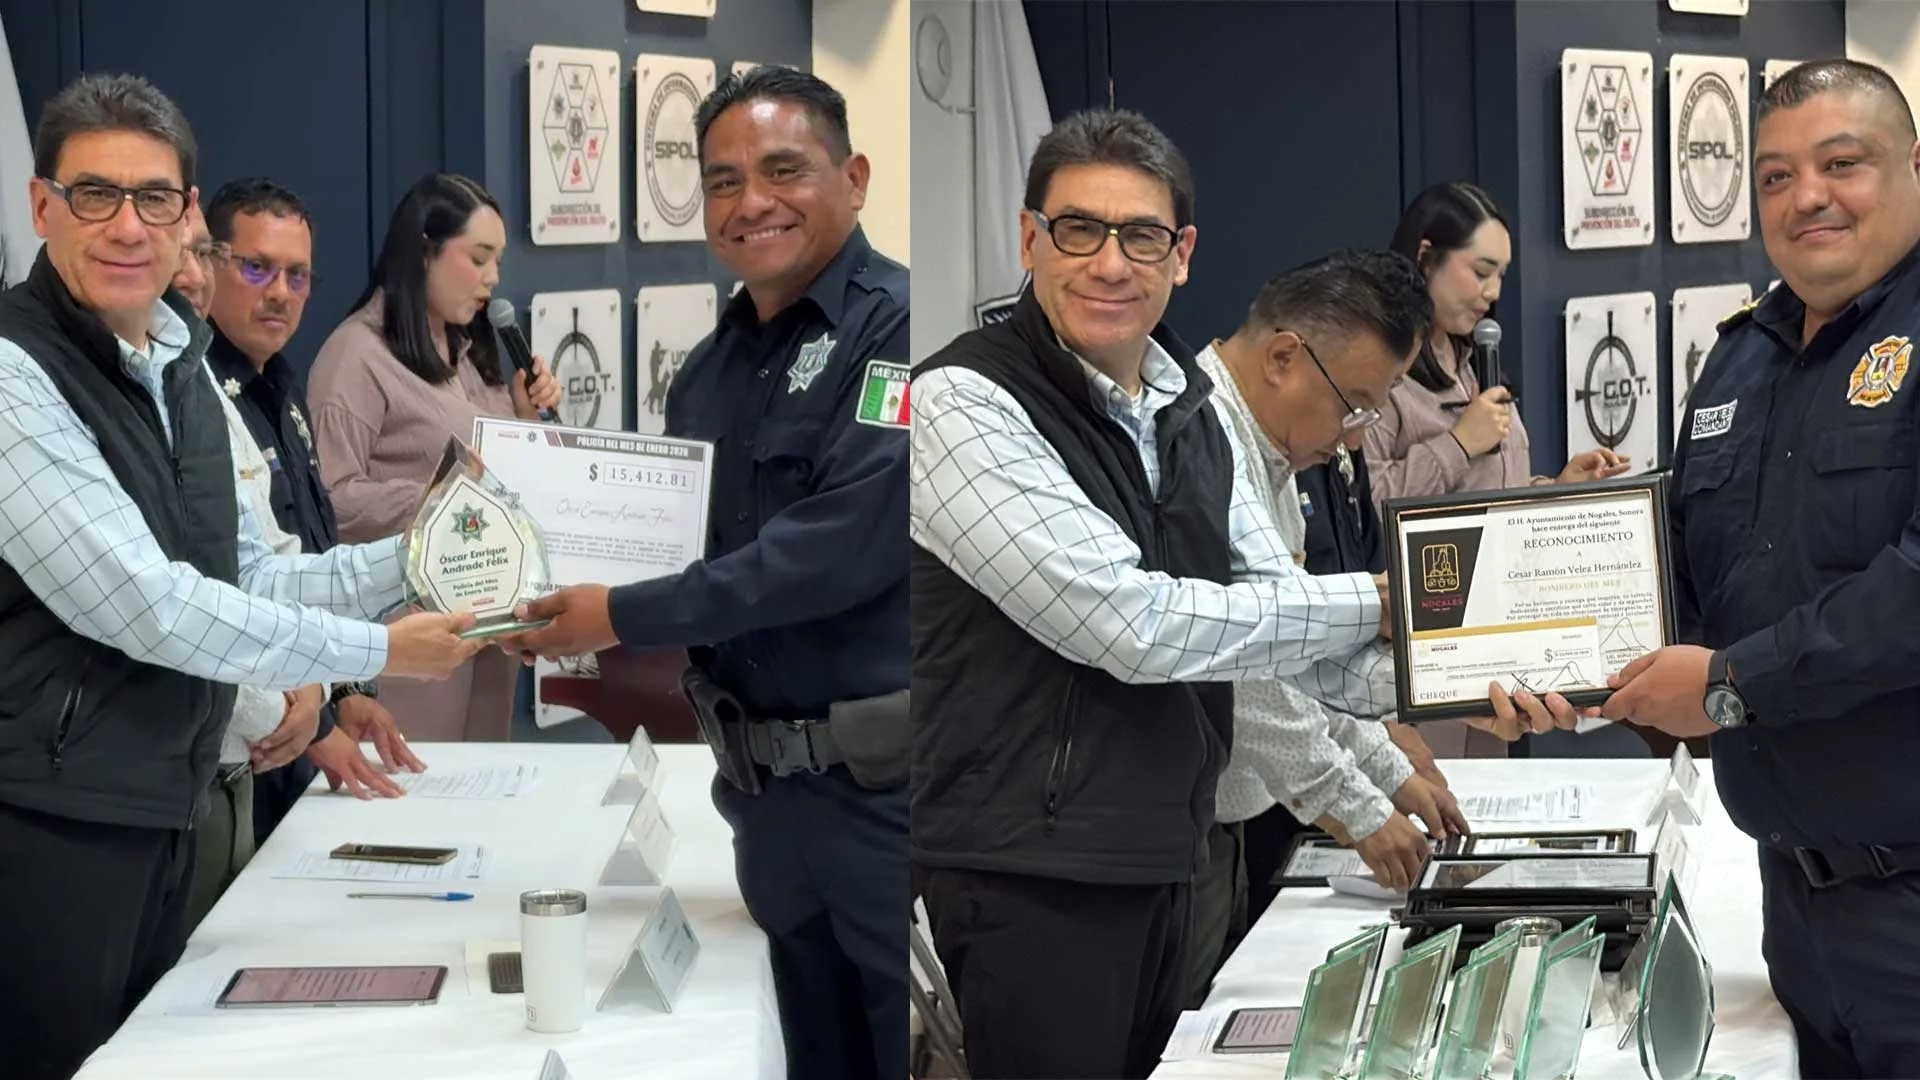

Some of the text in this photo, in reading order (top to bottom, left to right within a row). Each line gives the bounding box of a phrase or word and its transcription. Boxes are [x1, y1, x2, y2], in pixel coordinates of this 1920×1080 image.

[655, 141, 698, 159] SIPOL
[1689, 141, 1733, 159] SIPOL
[871, 366, 910, 382] MEXIC
[589, 462, 687, 487] $ 15,412.81
[1508, 518, 1515, 526] El
[1526, 514, 1577, 525] Ayuntamiento
[1577, 512, 1587, 520] de
[1588, 510, 1617, 520] Nogales,
[1618, 509, 1644, 517] Sonora
[1531, 519, 1621, 533] hace entrega del siguiente
[1524, 530, 1633, 549] RECONOCIMIENTO
[440, 546, 507, 564] Óscar Enrique
[442, 560, 485, 575] Andrade
[1508, 560, 1642, 579] Cesar Ramón Velez Hernández
[1422, 595, 1464, 608] NOGALES
[1545, 648, 1553, 663] $
[1419, 689, 1458, 701] CHEQUE
